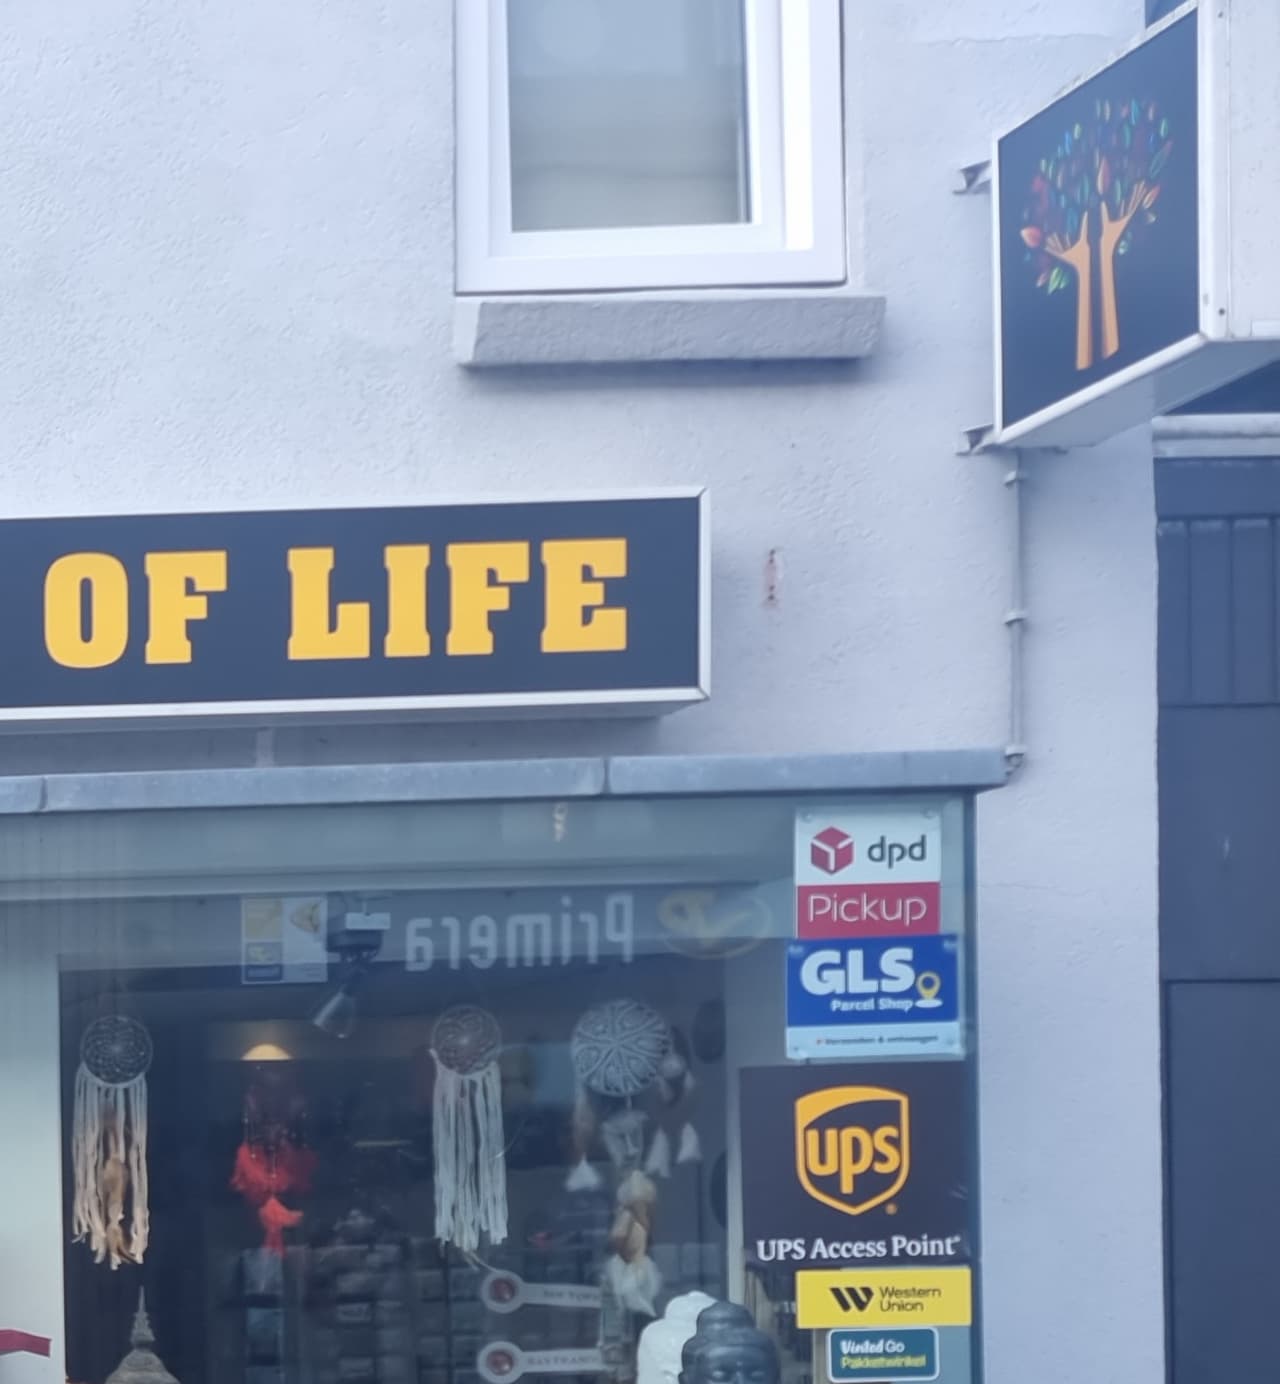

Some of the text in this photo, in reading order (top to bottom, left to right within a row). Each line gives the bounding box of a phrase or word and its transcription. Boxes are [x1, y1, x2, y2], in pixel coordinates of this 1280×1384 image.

[42, 548, 226, 668] OF
[286, 537, 628, 660] LIFE
[867, 834, 926, 869] dpd
[808, 893, 927, 926] Pickup
[800, 947, 916, 995] GLS
[830, 998, 914, 1012] Parcel Shop
[806, 1126, 901, 1194] ups
[757, 1235, 956, 1261] UPS Access Point
[879, 1287, 942, 1298] Western
[880, 1301, 924, 1312] Union
[841, 1340, 905, 1354] Vinted Go
